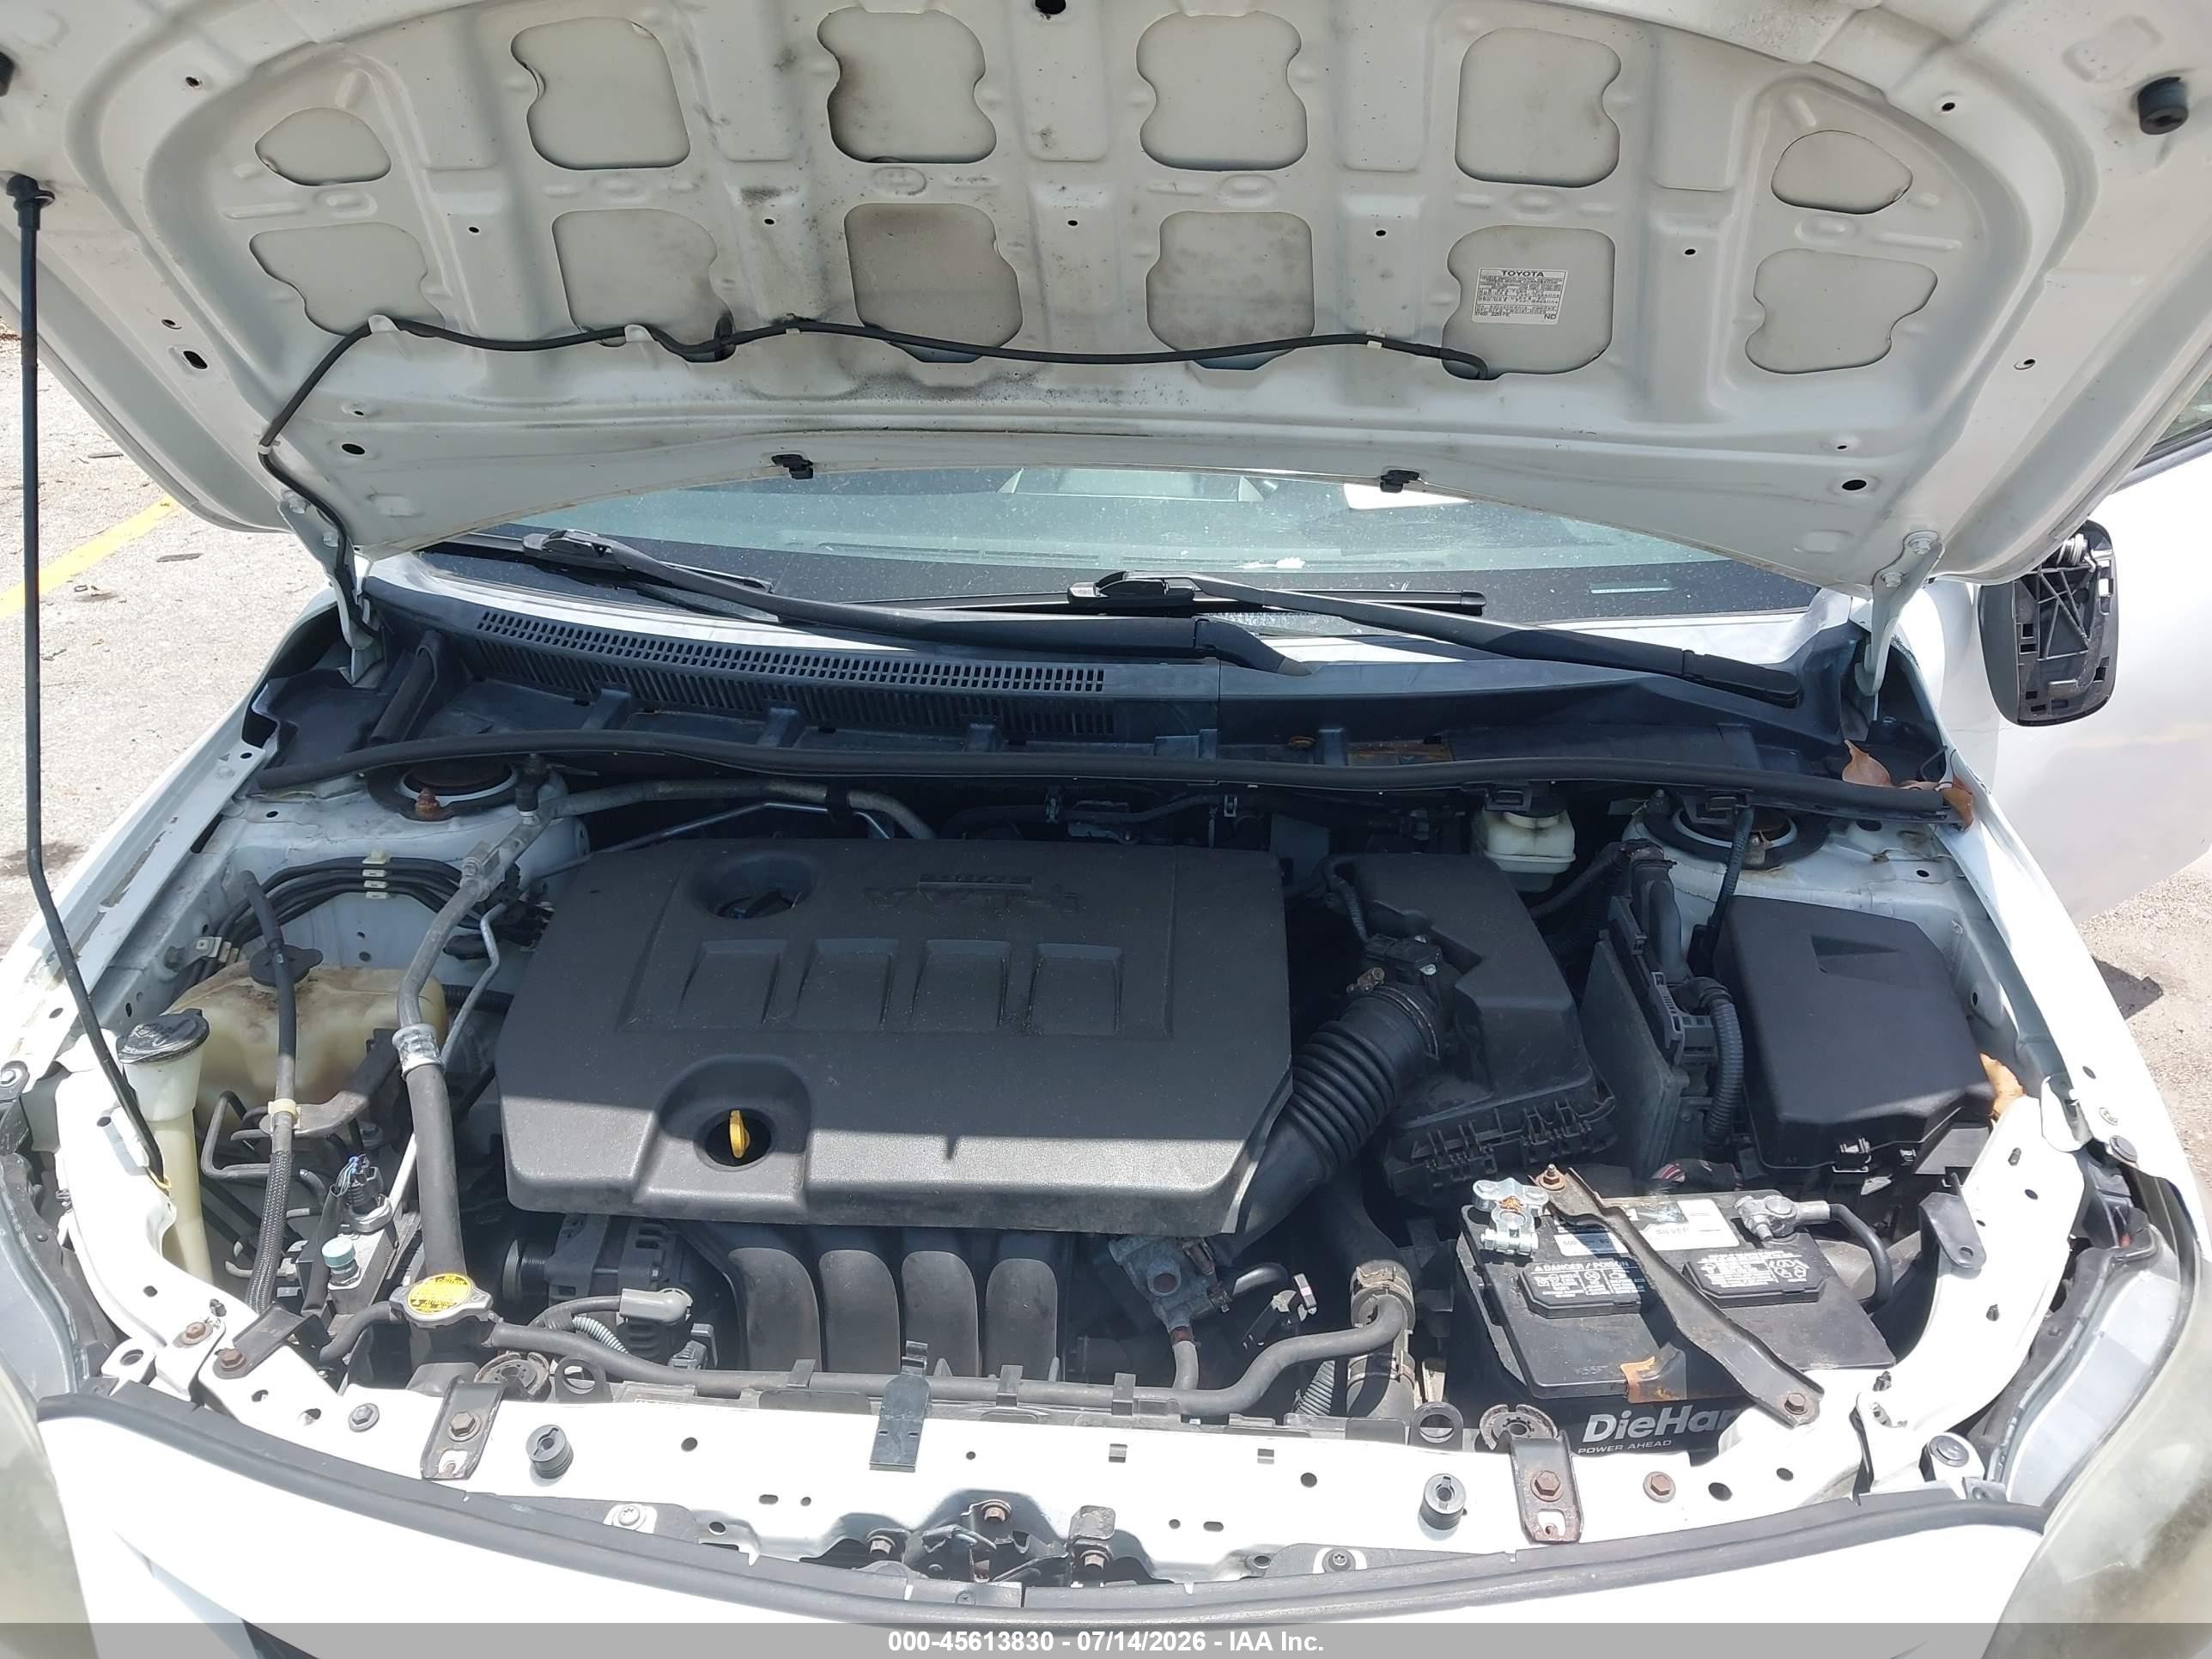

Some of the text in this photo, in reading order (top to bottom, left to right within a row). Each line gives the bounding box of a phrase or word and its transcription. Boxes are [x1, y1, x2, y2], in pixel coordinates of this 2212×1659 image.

[1543, 1262, 1584, 1272] DANGER
[1582, 1405, 1741, 1443] DieHar
[1577, 1439, 1672, 1455] POWER AHEAD
